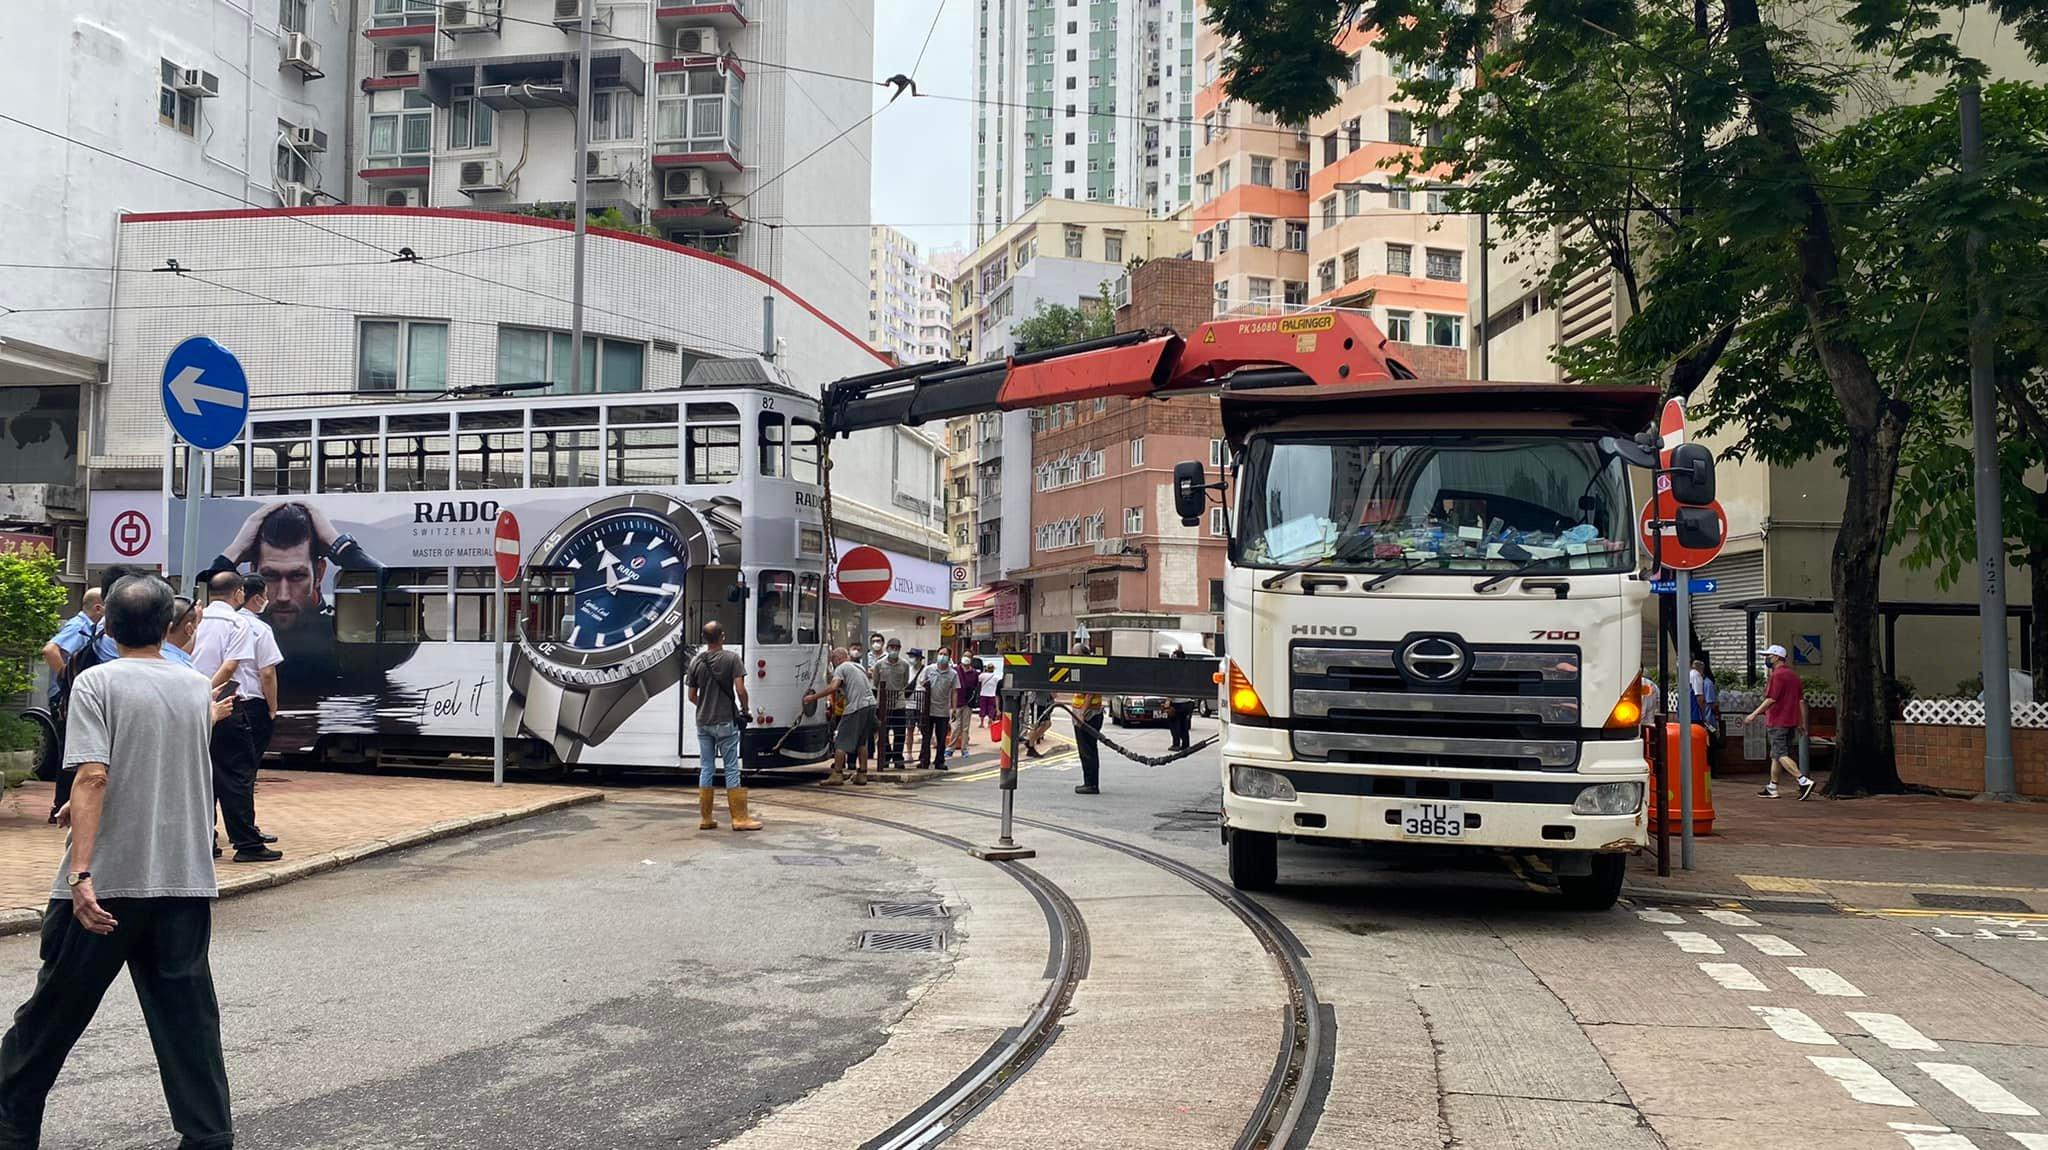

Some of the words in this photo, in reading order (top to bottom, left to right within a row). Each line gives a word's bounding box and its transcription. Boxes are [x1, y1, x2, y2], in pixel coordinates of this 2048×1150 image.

[762, 397, 775, 410] 82
[413, 500, 500, 523] RADO
[413, 527, 496, 536] SWITZERLAN
[412, 548, 442, 558] MASTER
[444, 548, 455, 558] OF
[457, 547, 494, 557] MATERIAL
[616, 564, 641, 582] RADO
[1291, 624, 1357, 637] HINO
[1529, 630, 1580, 641] 700
[416, 679, 463, 725] Feel
[469, 675, 494, 716] it
[1420, 804, 1447, 820] TU
[1406, 818, 1460, 836] 3863
